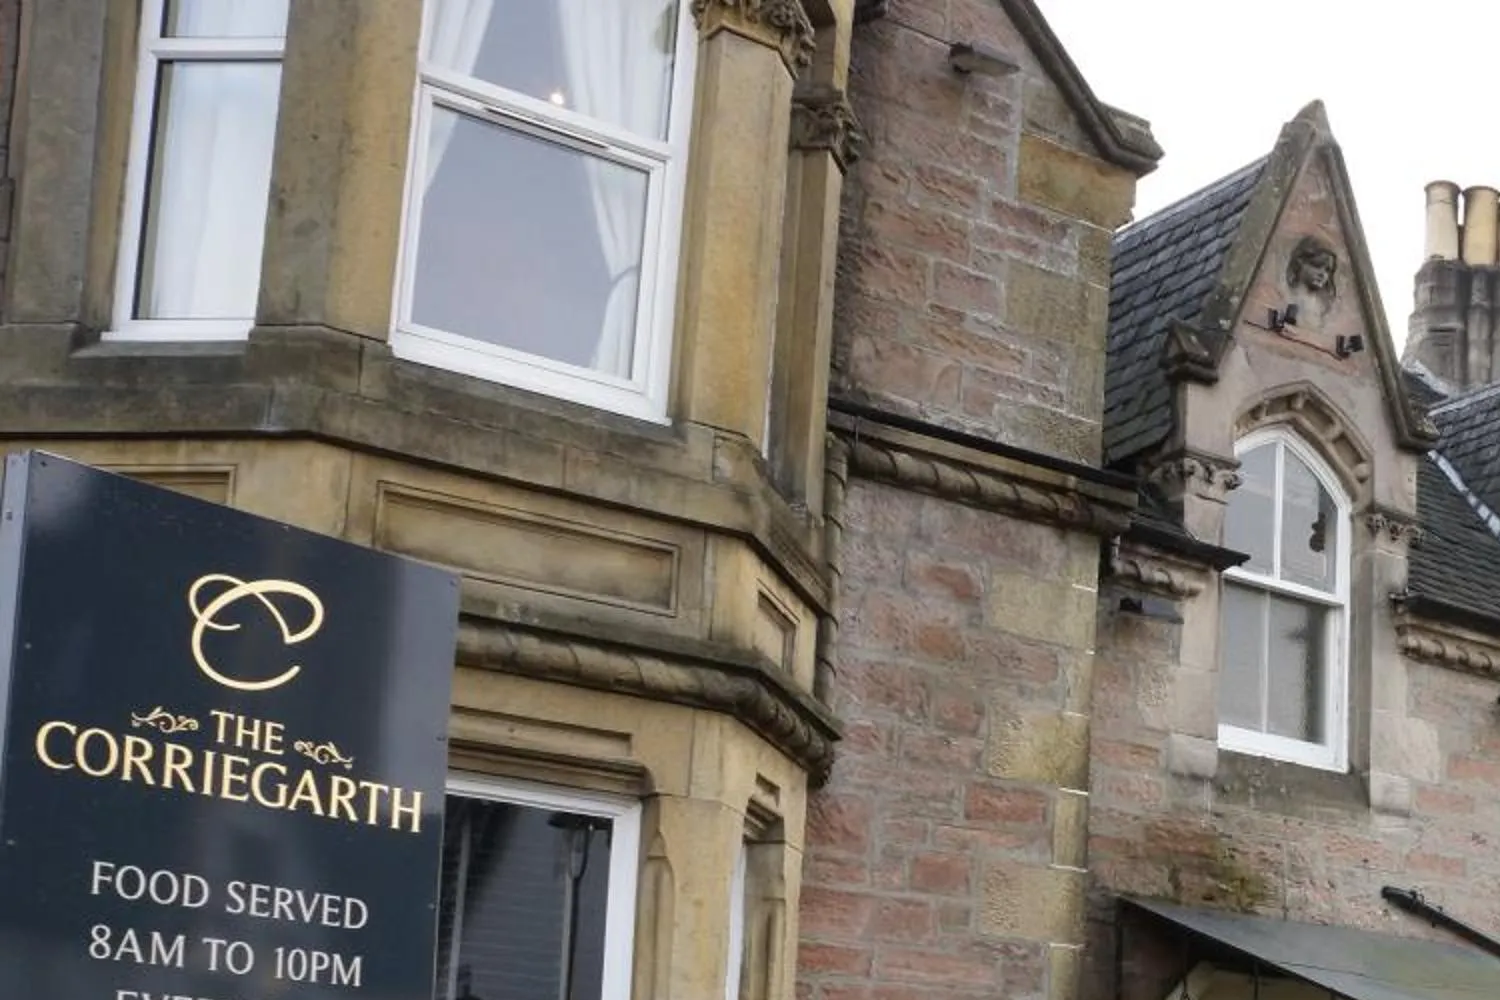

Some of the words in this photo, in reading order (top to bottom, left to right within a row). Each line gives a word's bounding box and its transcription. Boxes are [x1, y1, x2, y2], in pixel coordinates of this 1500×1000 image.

[210, 709, 286, 755] THE
[35, 720, 424, 833] CORRIEGARTH
[91, 860, 210, 908] FOOD
[225, 880, 369, 929] SERVED
[89, 924, 186, 969] 8AM
[202, 937, 254, 975] TO
[274, 946, 362, 987] 10PM
